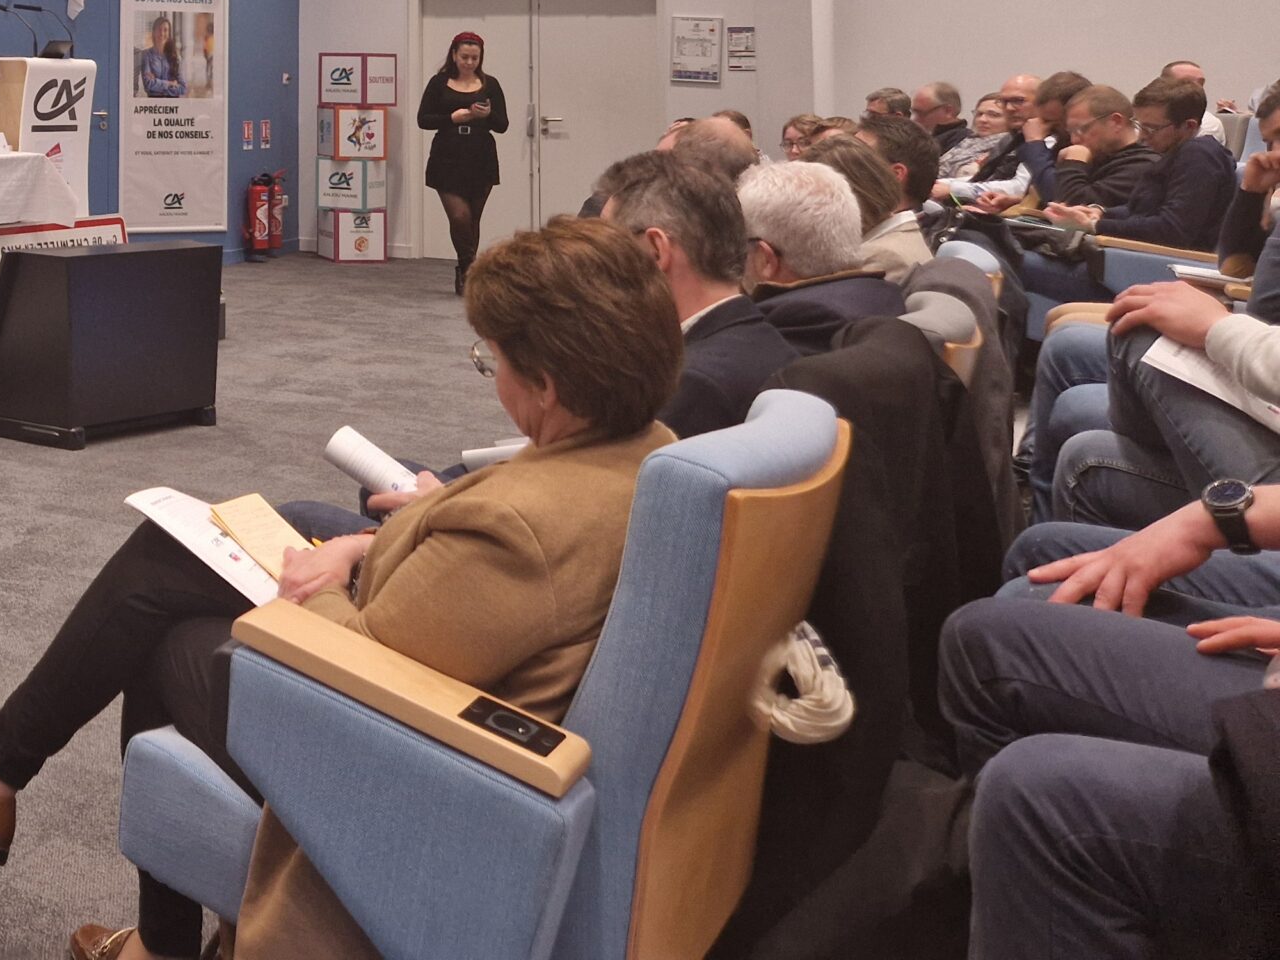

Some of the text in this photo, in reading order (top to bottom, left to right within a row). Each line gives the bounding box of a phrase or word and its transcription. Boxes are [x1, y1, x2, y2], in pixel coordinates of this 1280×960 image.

[133, 104, 179, 115] APPRÉCIENT
[153, 117, 195, 127] LA QUALITÉ
[146, 130, 157, 139] DE
[158, 130, 173, 139] NOS
